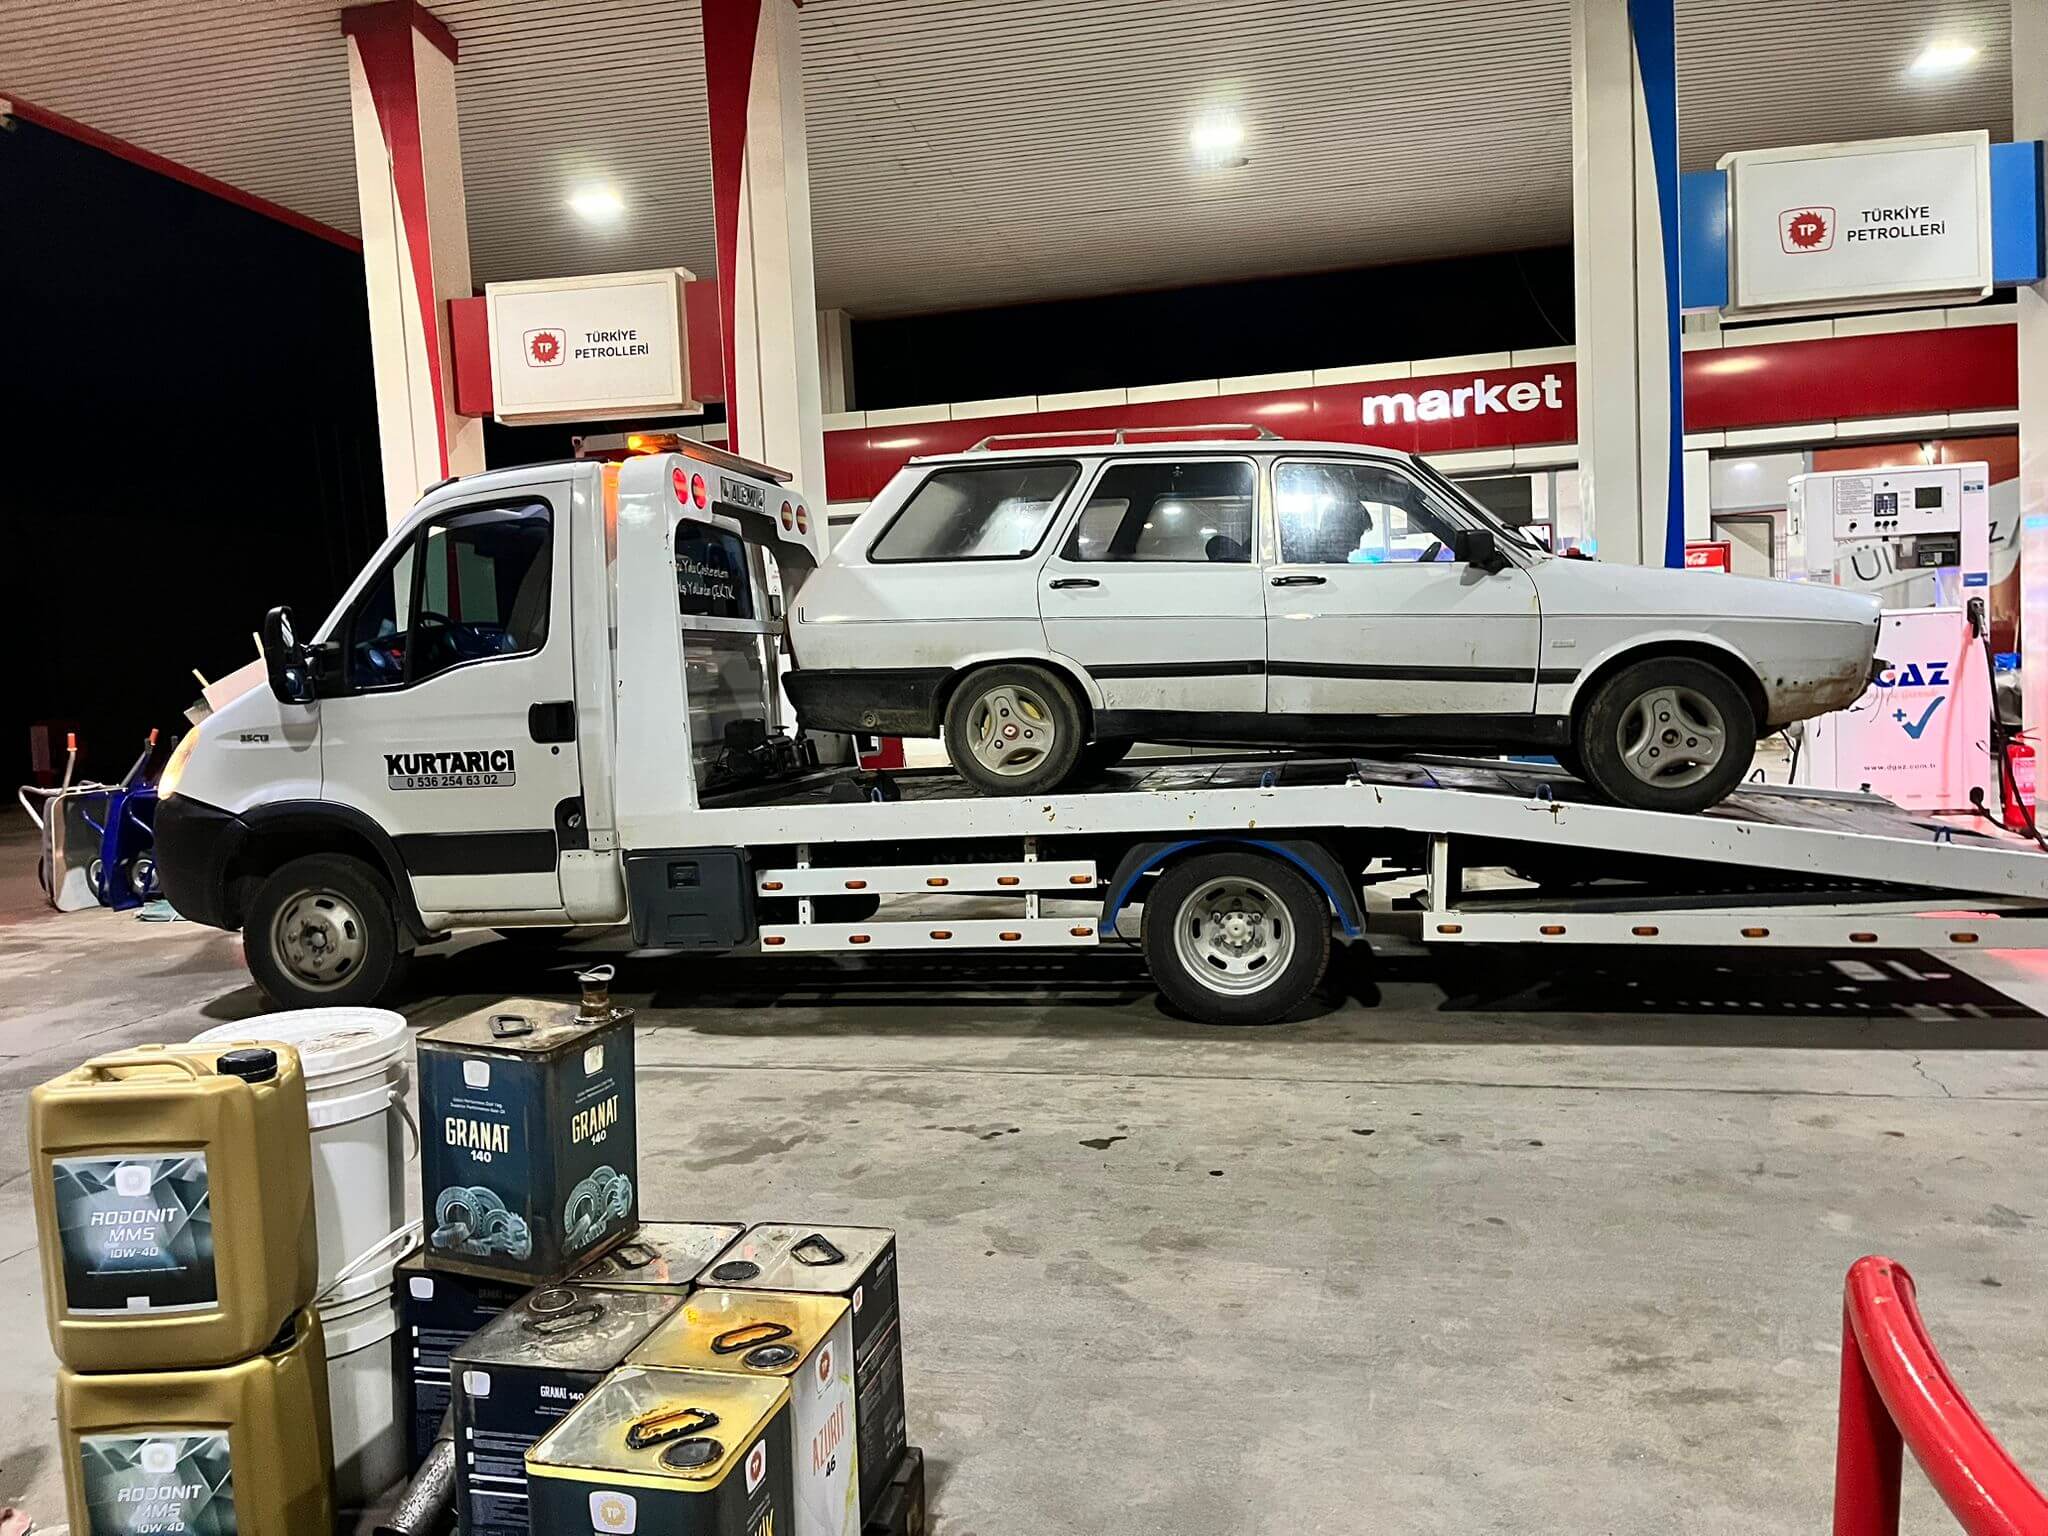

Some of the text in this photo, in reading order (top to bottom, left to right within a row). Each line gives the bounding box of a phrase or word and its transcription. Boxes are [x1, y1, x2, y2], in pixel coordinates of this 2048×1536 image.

[1862, 205, 1930, 222] TÜRKİYE
[1798, 223, 1817, 236] TP
[1847, 220, 1945, 241] PETROLLERİ
[585, 329, 637, 343] TÜRKİYE
[538, 342, 553, 353] TP
[575, 342, 649, 359] PETROLLERİ
[1361, 374, 1563, 426] market
[384, 749, 515, 775] KURTARICI
[407, 774, 498, 788] 0 536 254 63 02
[571, 1094, 619, 1145] GRANAT
[445, 1116, 510, 1154] GRANAT
[590, 1129, 607, 1146] 140
[471, 1150, 492, 1163] 140
[91, 1207, 178, 1226] RODONIT
[109, 1227, 155, 1242] MMS
[110, 1247, 159, 1259] 10W-40
[568, 1392, 585, 1401] 140
[606, 1507, 621, 1519] TP
